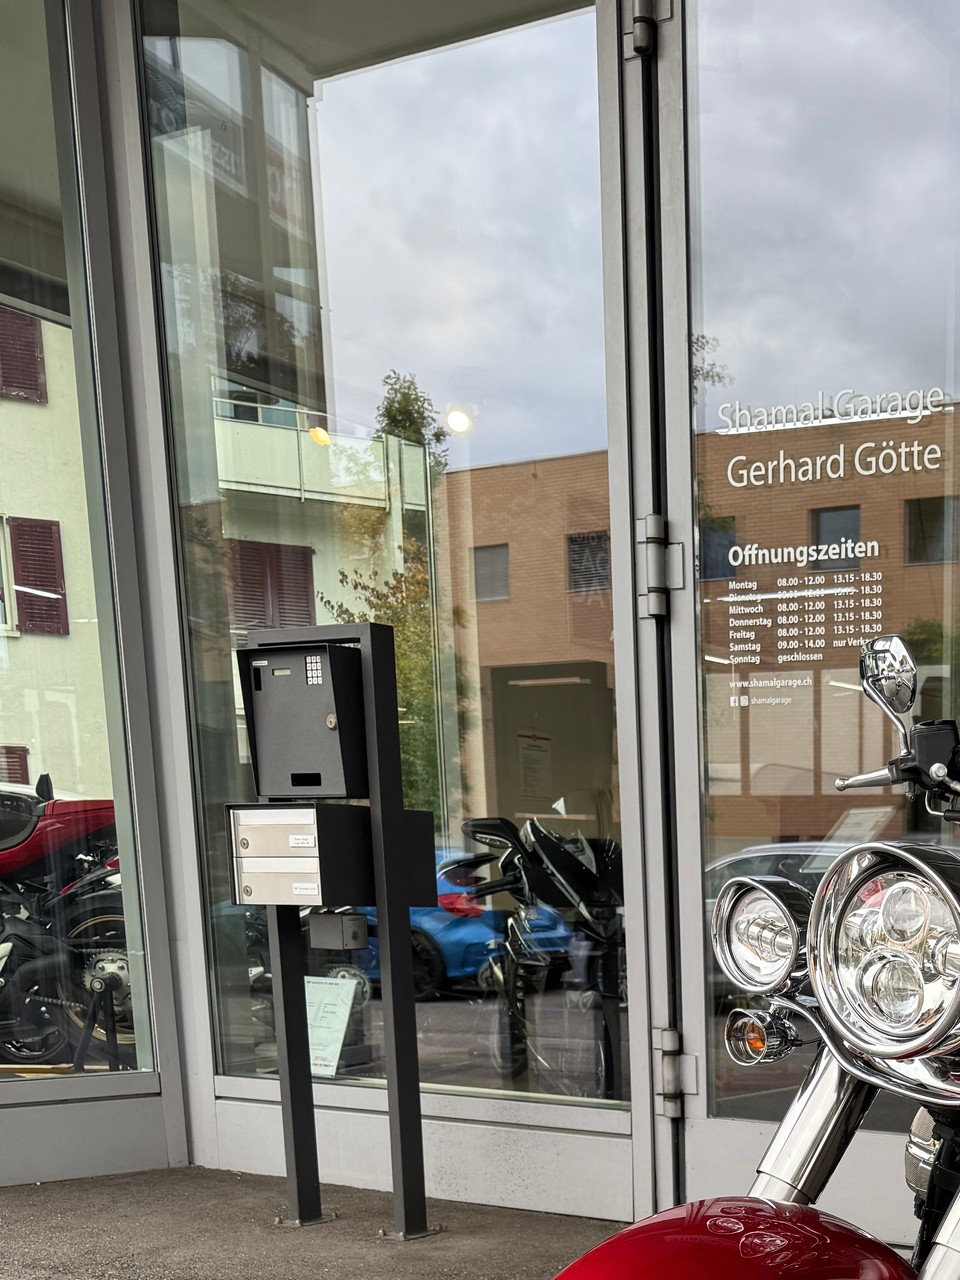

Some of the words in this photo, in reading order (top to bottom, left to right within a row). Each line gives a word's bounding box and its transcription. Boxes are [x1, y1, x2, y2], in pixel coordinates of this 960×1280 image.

[717, 390, 824, 435] Shamal
[833, 386, 944, 424] Garage
[727, 444, 845, 488] Gerhard
[854, 440, 942, 476] Götte
[728, 581, 757, 590] Montag
[777, 577, 798, 586] 08.00
[804, 576, 825, 585] 12.00
[833, 574, 854, 583] 13.15
[861, 572, 882, 581] 18.30
[861, 585, 882, 594] 18.30
[728, 604, 763, 614] Mittwoch
[777, 602, 798, 611] 08.00
[804, 602, 825, 610] 12.00
[833, 600, 854, 609] 13.15
[861, 598, 882, 607] 18.30
[729, 617, 772, 627] Donnerstag
[777, 615, 798, 624] 08.00
[804, 614, 825, 623] 12.00
[833, 612, 854, 621] 13.15
[861, 611, 882, 620] 18.30
[729, 630, 755, 640] Freitag
[777, 628, 798, 637] 08.00
[804, 627, 825, 635] 12.00
[833, 625, 854, 634] 13.15
[861, 624, 882, 633] 18.30
[729, 642, 761, 652] Samstag
[777, 640, 798, 649] 09.00
[804, 639, 825, 648] 14.00
[729, 655, 760, 664] Sonntag
[777, 652, 823, 663] geschlossen
[729, 676, 812, 688] www.shamalgarage.ch
[751, 696, 792, 705] shamalgarage
